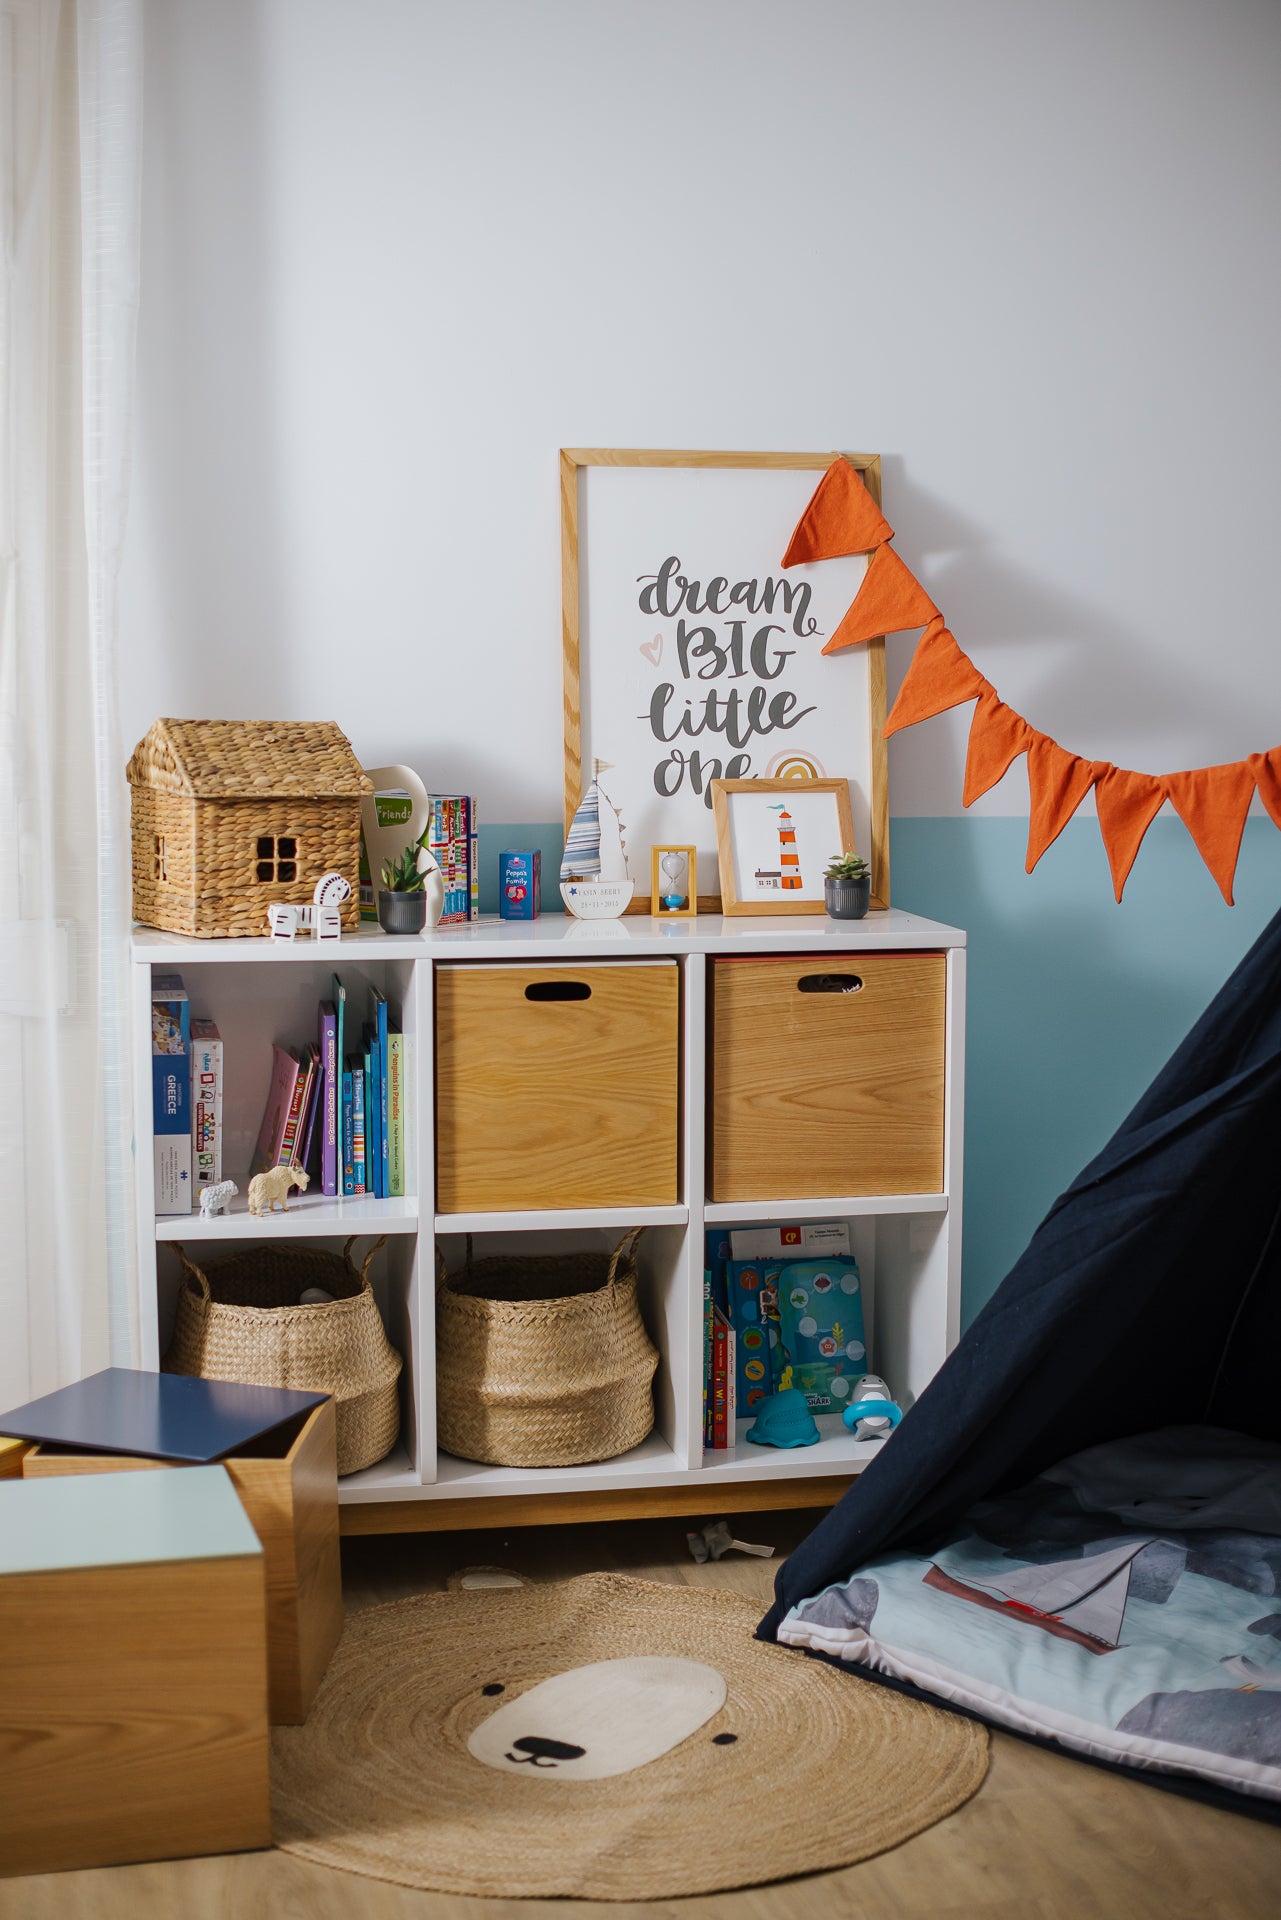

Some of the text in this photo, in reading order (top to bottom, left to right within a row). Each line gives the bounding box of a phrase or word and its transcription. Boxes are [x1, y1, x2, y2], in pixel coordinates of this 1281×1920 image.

[636, 556, 825, 638] dream
[677, 619, 796, 680] BIG
[636, 682, 818, 749] little
[653, 748, 759, 810] one
[377, 805, 411, 820] Friends
[505, 869, 528, 878] Peppa's
[505, 878, 528, 886] Family
[391, 1053, 399, 1084] Penguins
[167, 1074, 177, 1115] GREECE
[292, 1087, 304, 1112] Nursery
[785, 1232, 796, 1244] CP
[716, 1370, 726, 1426] Pinwheel
